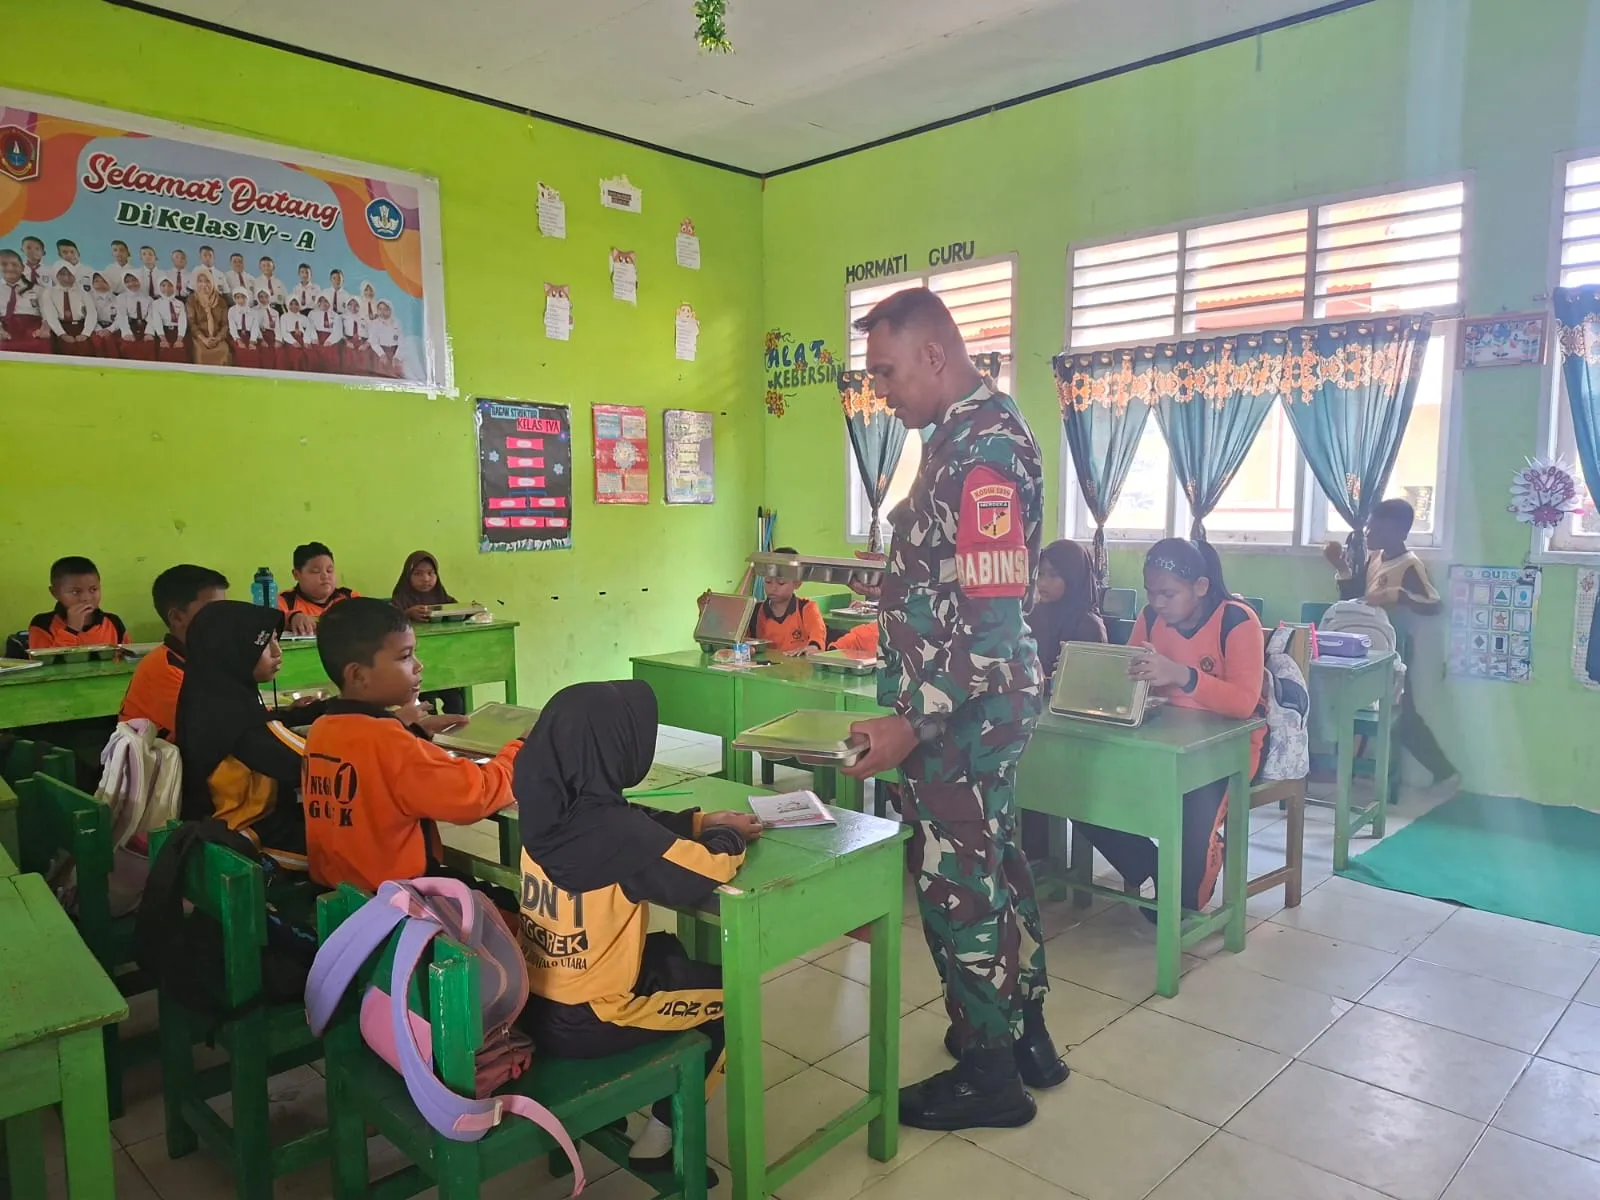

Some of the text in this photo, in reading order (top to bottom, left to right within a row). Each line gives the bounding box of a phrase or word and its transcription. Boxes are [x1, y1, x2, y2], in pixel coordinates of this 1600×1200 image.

[83, 153, 340, 229] Selamat Datang
[117, 202, 152, 226] Di
[157, 208, 240, 239] Kelas
[243, 221, 276, 243] IV
[296, 231, 314, 249] A
[846, 240, 975, 284] HORMATI GURU
[517, 418, 543, 431] KELAS
[955, 550, 1029, 586] BABINS
[521, 871, 559, 921] DN
[560, 957, 587, 970] UTARA
